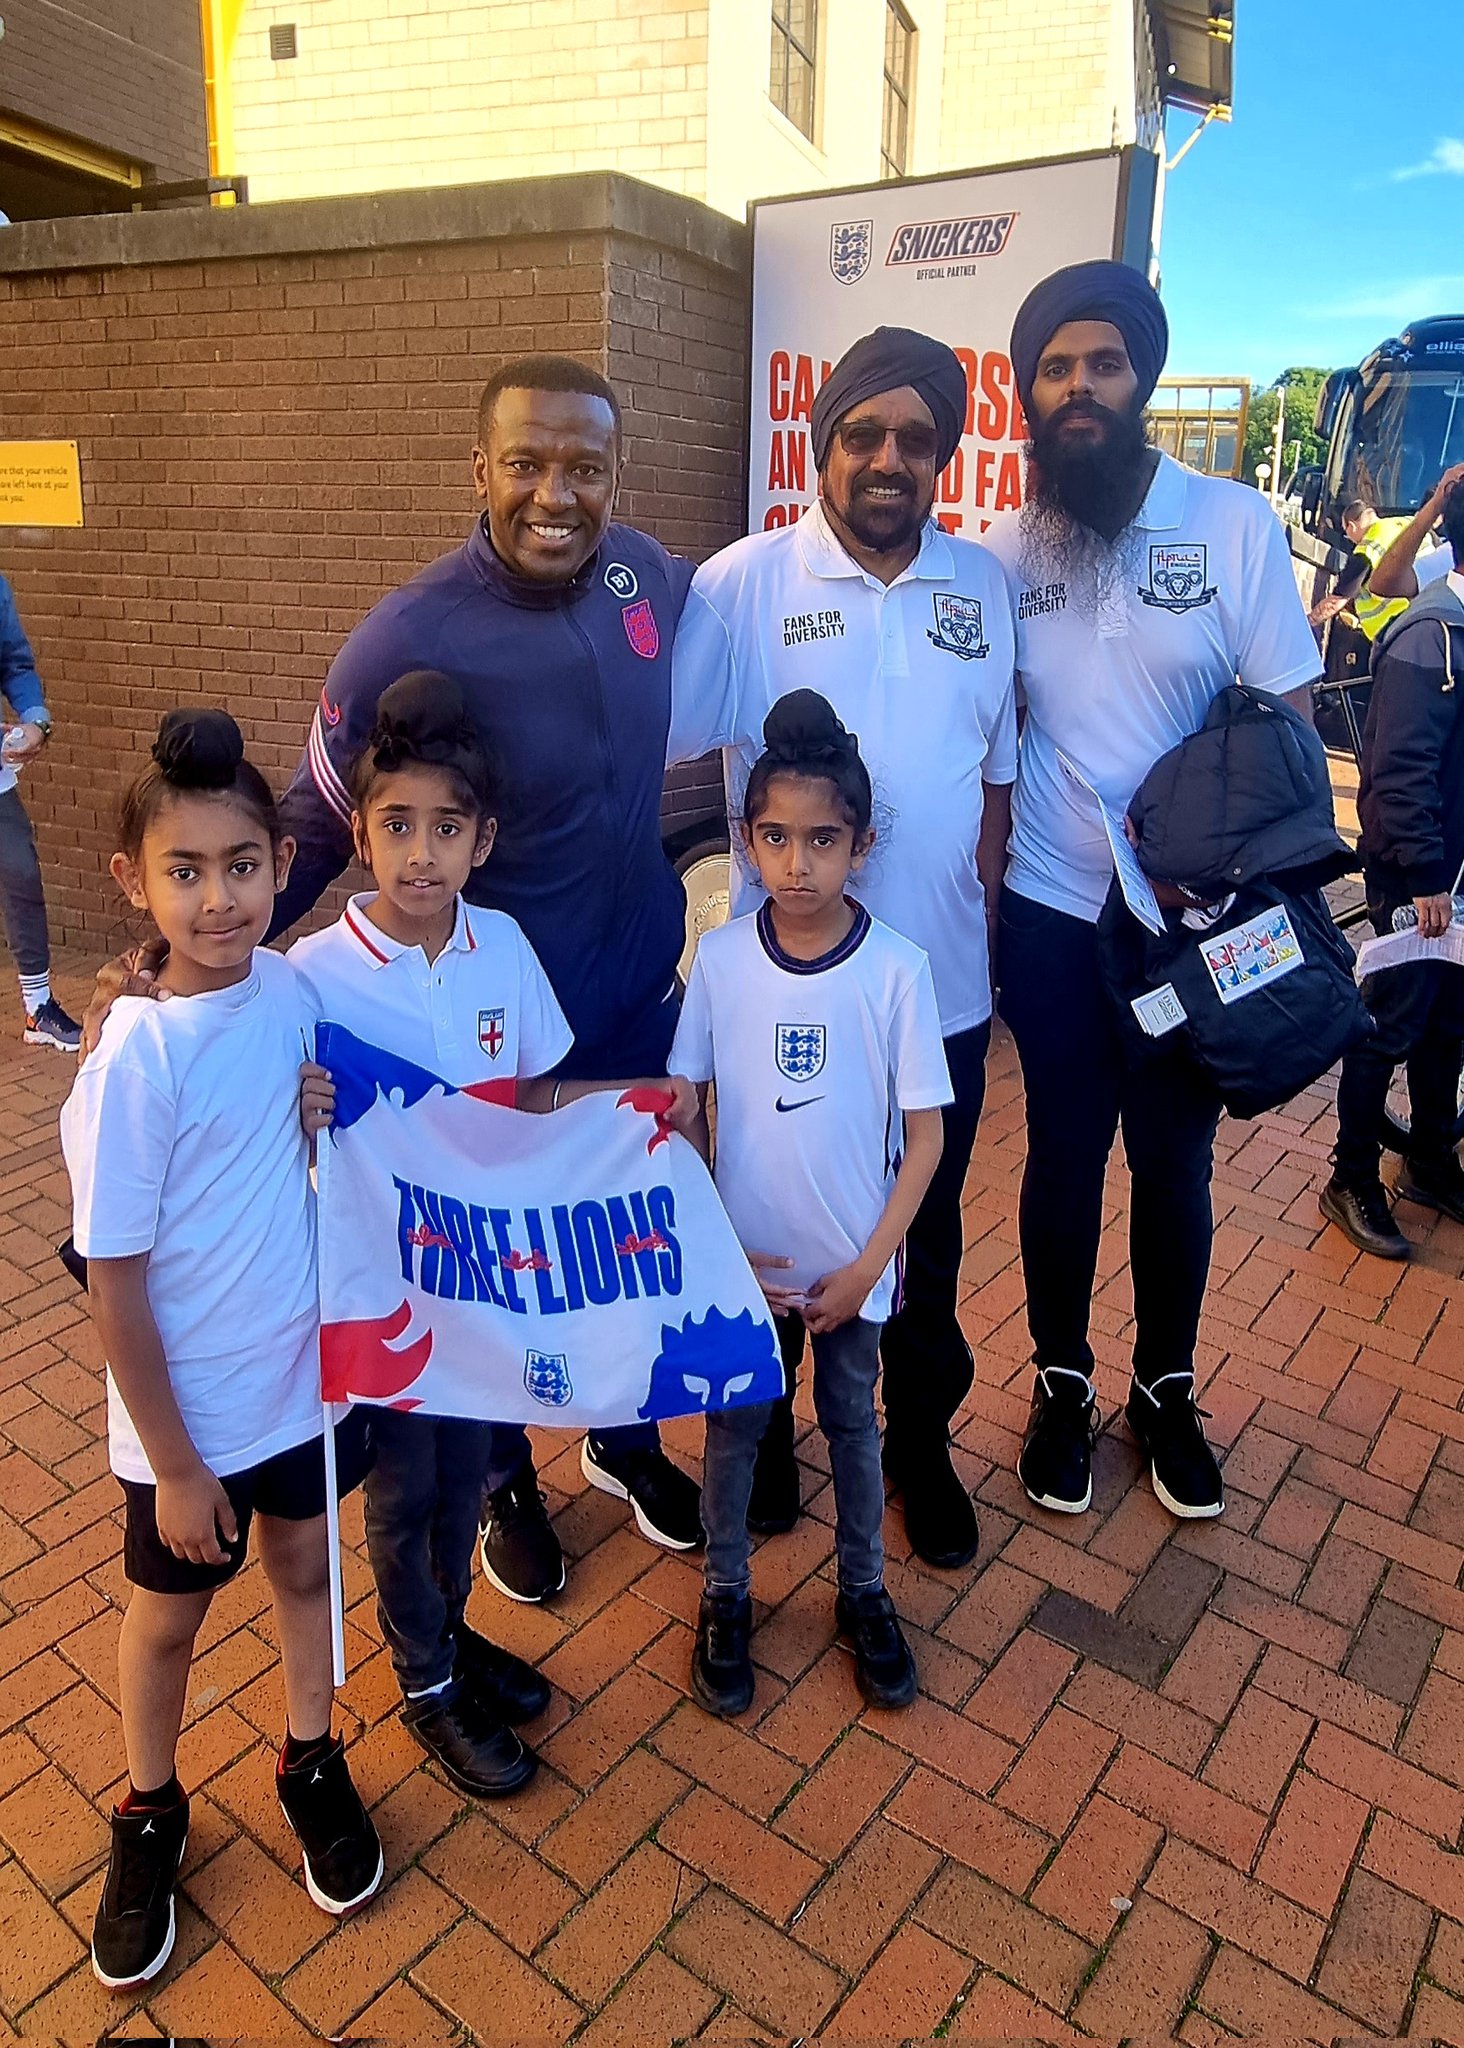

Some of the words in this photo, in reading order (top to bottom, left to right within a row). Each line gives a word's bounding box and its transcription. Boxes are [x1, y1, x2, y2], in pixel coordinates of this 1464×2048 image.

[891, 217, 1010, 263] SNICKERS
[916, 267, 944, 280] OFFICIAL
[947, 265, 976, 279] PARTNER
[768, 430, 806, 492] AN
[610, 571, 629, 589] BT
[1019, 586, 1042, 606] FANS
[1046, 582, 1066, 598] FOR
[1018, 595, 1068, 621] DIVERSITY
[784, 614, 814, 632] FANS
[818, 610, 842, 625] FOR
[783, 623, 845, 647] DIVERSITY
[392, 1172, 527, 1315] THREE
[524, 1185, 683, 1315] LIONS
